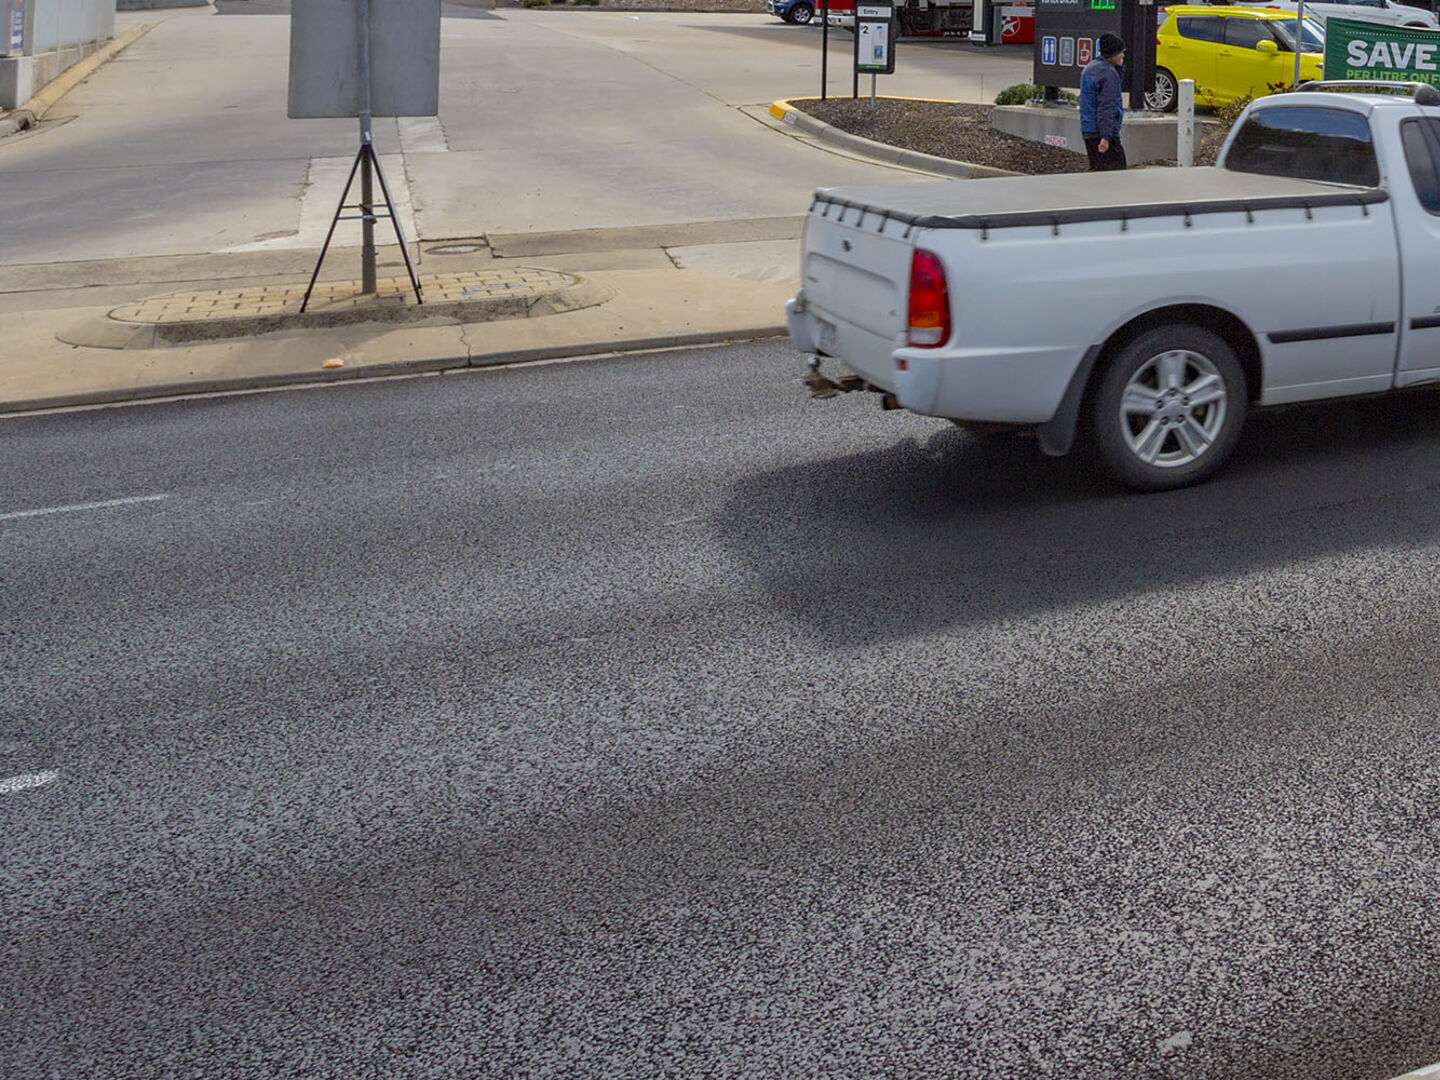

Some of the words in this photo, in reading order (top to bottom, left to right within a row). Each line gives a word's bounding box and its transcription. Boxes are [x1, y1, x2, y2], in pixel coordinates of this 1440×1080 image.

[1346, 40, 1438, 69] SAVE
[1346, 69, 1370, 80] PER
[1372, 71, 1409, 81] LITRE
[1410, 72, 1429, 83] ON
